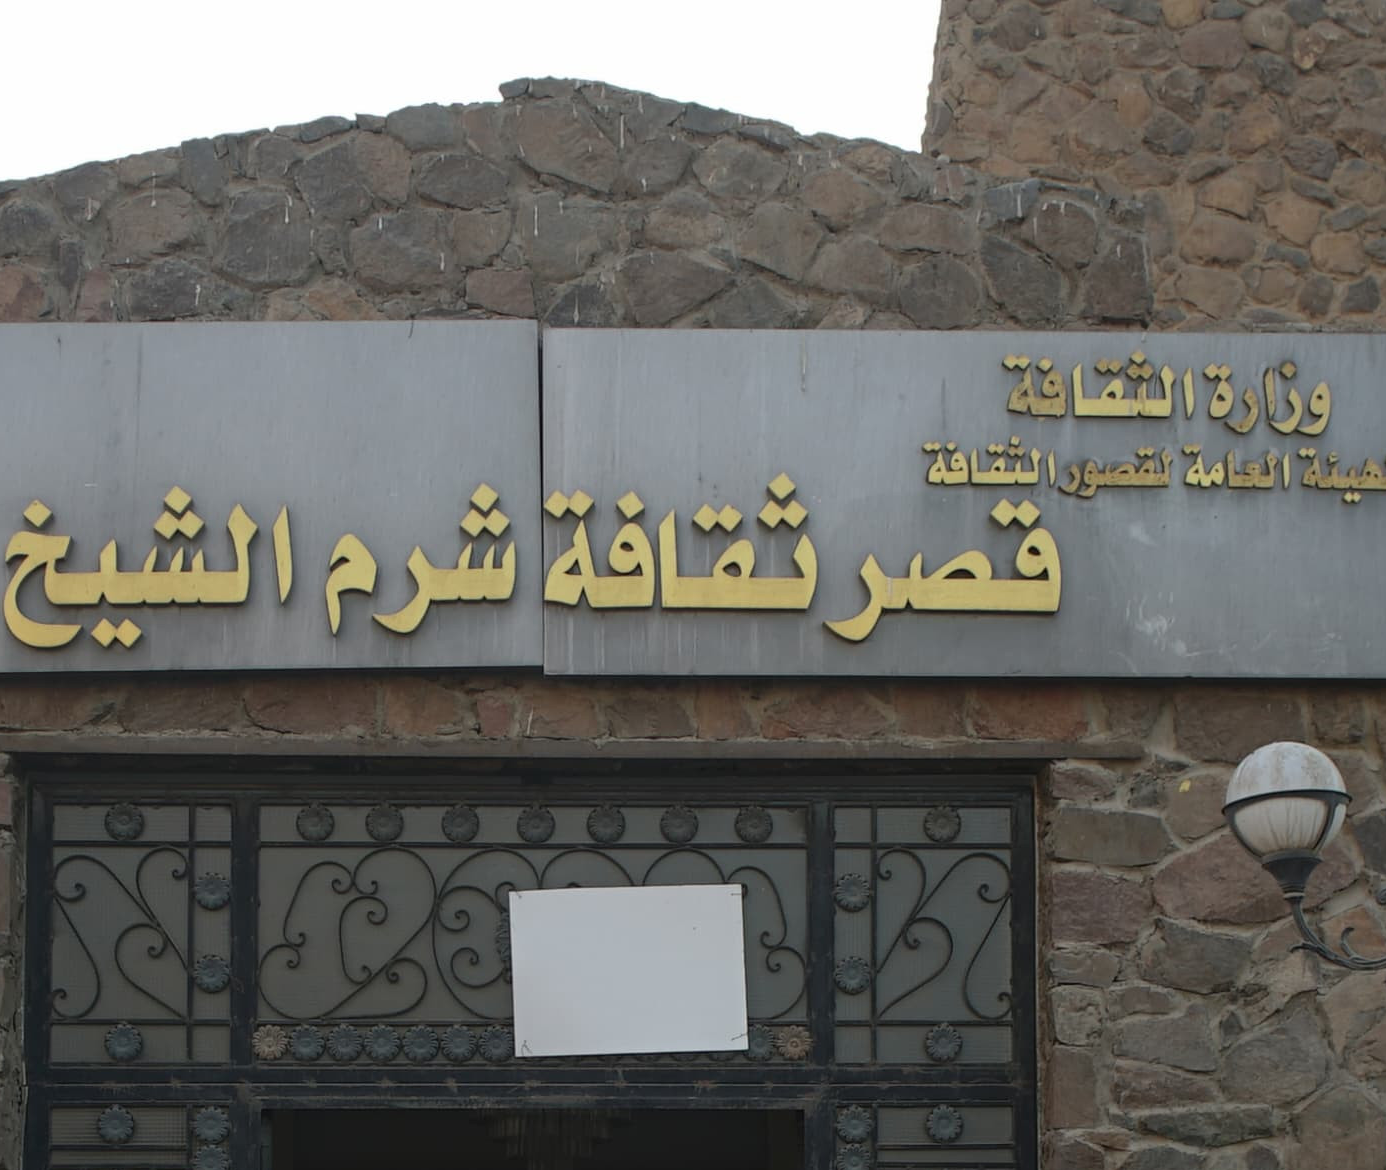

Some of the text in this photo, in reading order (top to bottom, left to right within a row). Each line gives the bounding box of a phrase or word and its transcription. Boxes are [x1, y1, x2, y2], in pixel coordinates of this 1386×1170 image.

[1002, 350, 1332, 435] وزارة الثقافة
[922, 436, 1057, 487] الثقافة
[1057, 446, 1174, 498] لقصور
[1181, 445, 1291, 490] العامة
[2, 473, 1063, 649] قصر ثقافة شرم الشيخ
